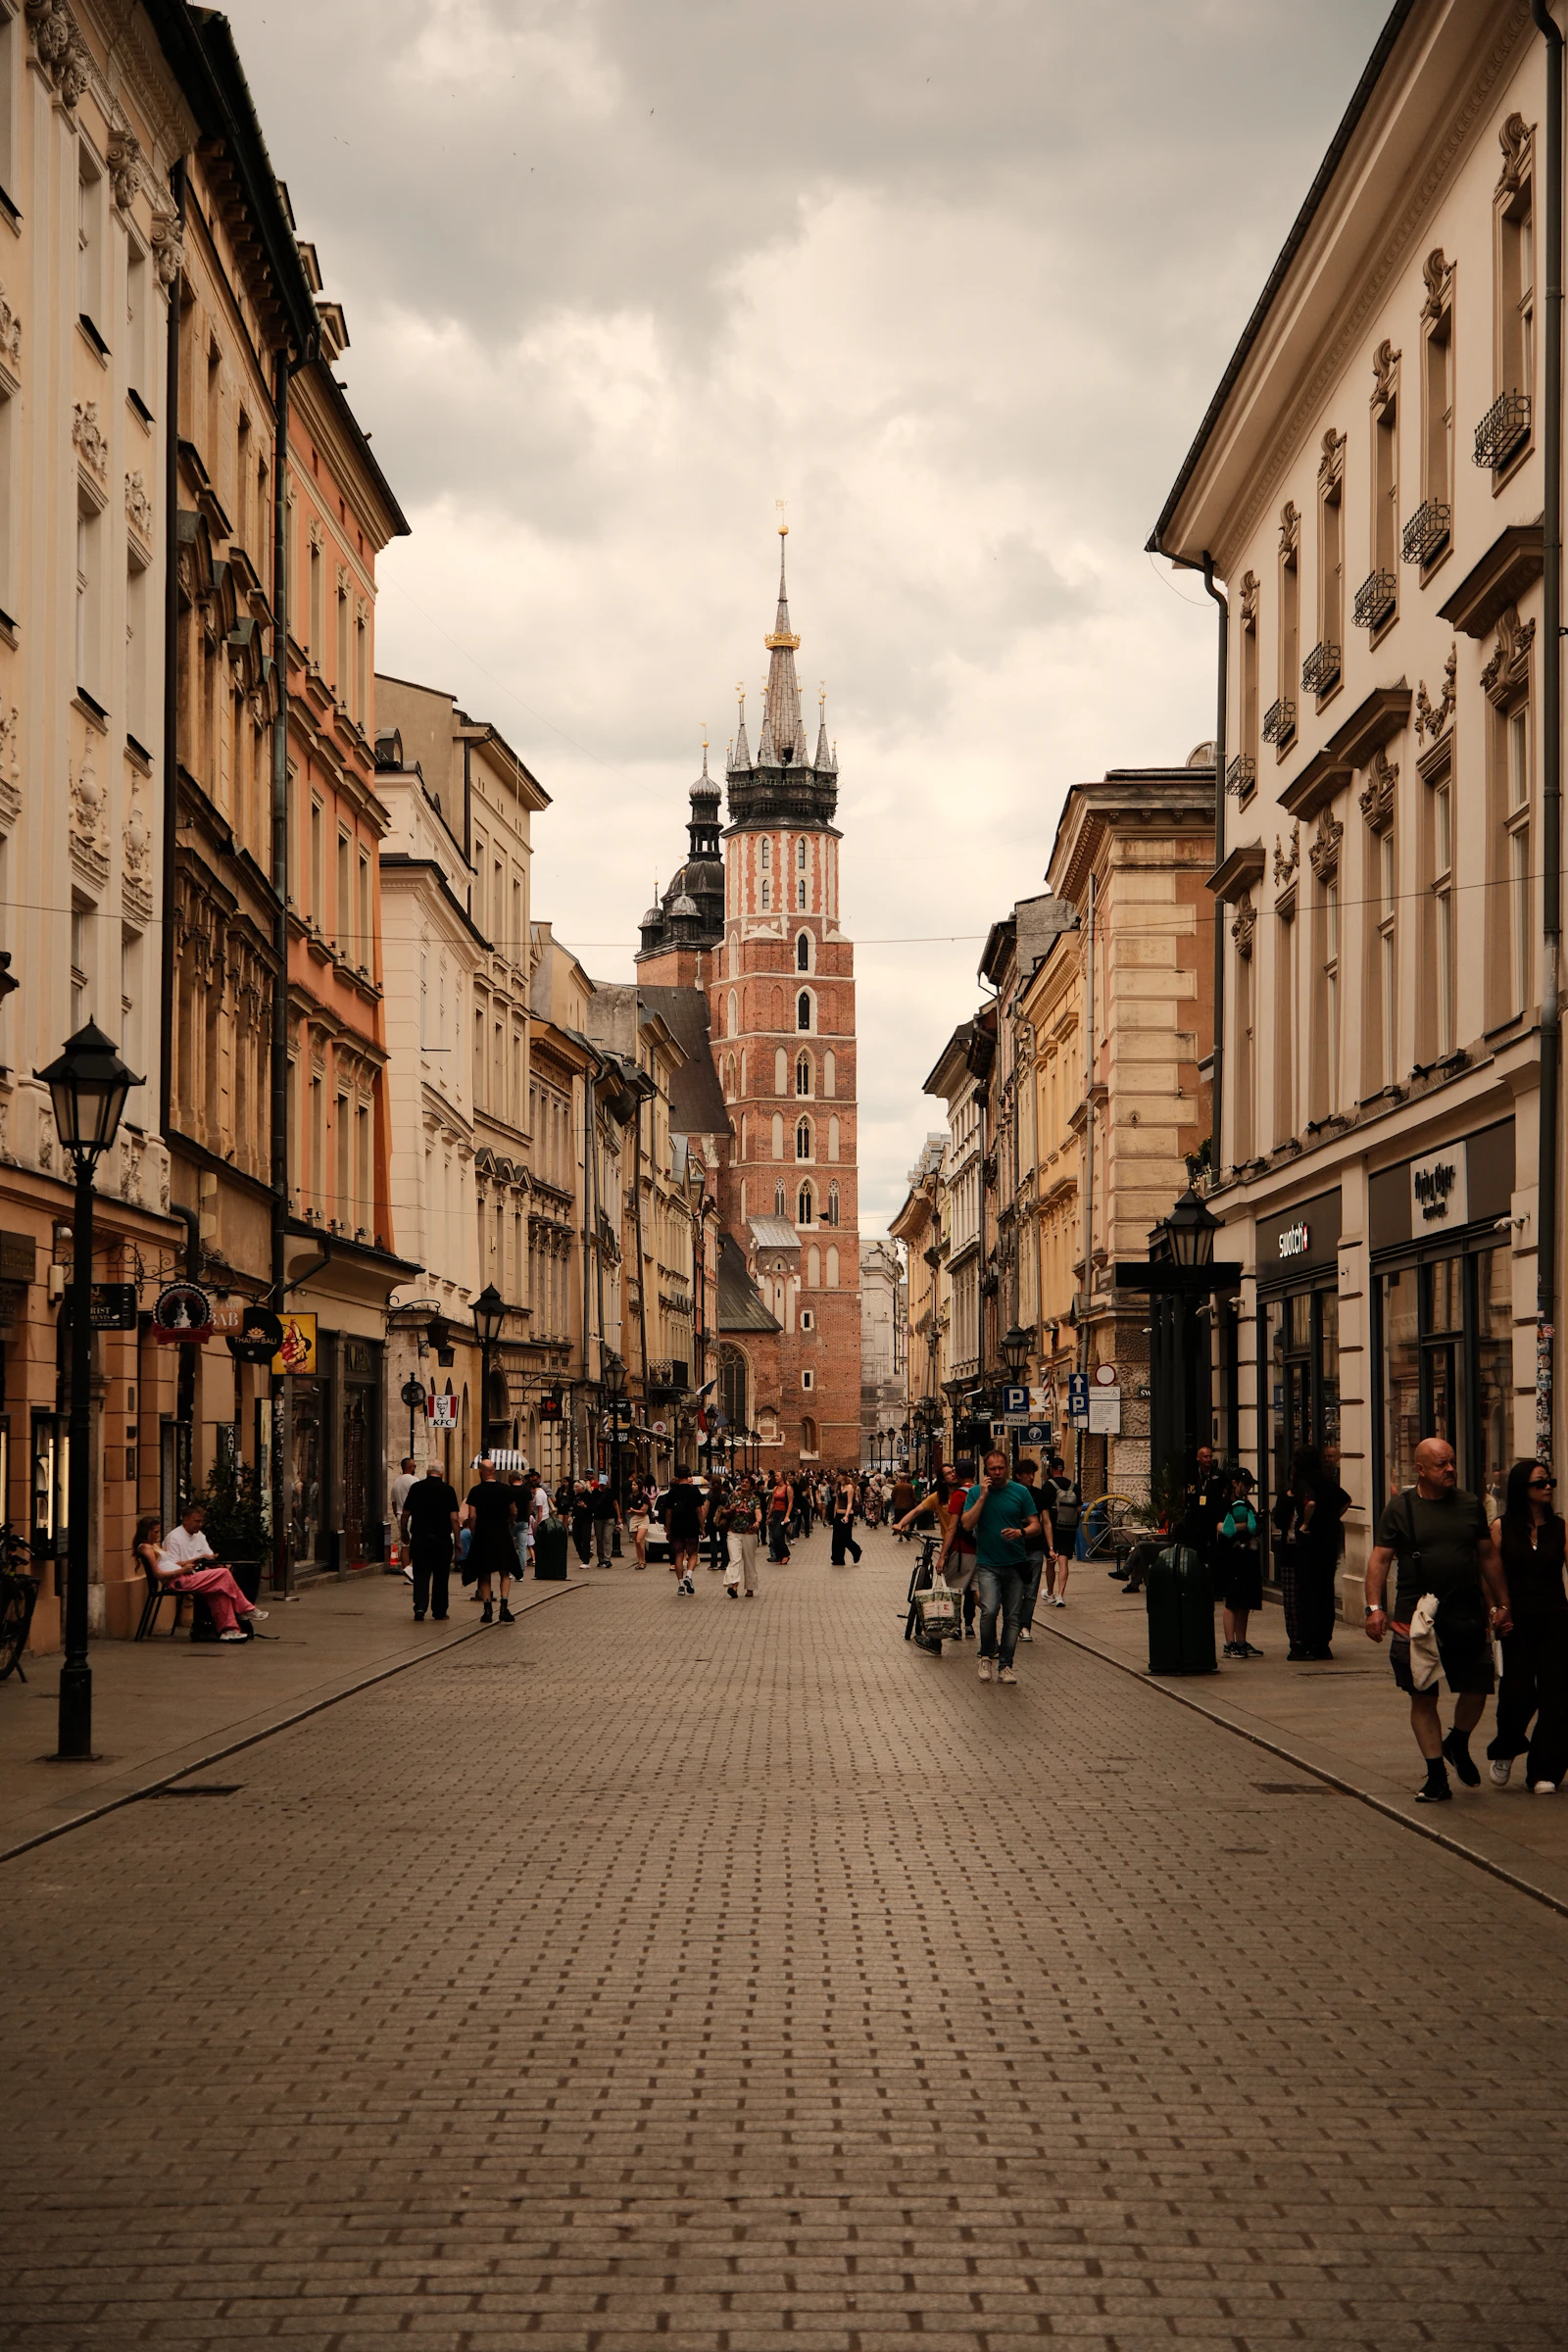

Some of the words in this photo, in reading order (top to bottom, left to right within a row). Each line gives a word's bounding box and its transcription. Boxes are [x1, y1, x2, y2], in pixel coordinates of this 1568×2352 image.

[1278, 1221, 1303, 1258] swatch
[1008, 1389, 1024, 1410] P
[1072, 1396, 1085, 1413] P
